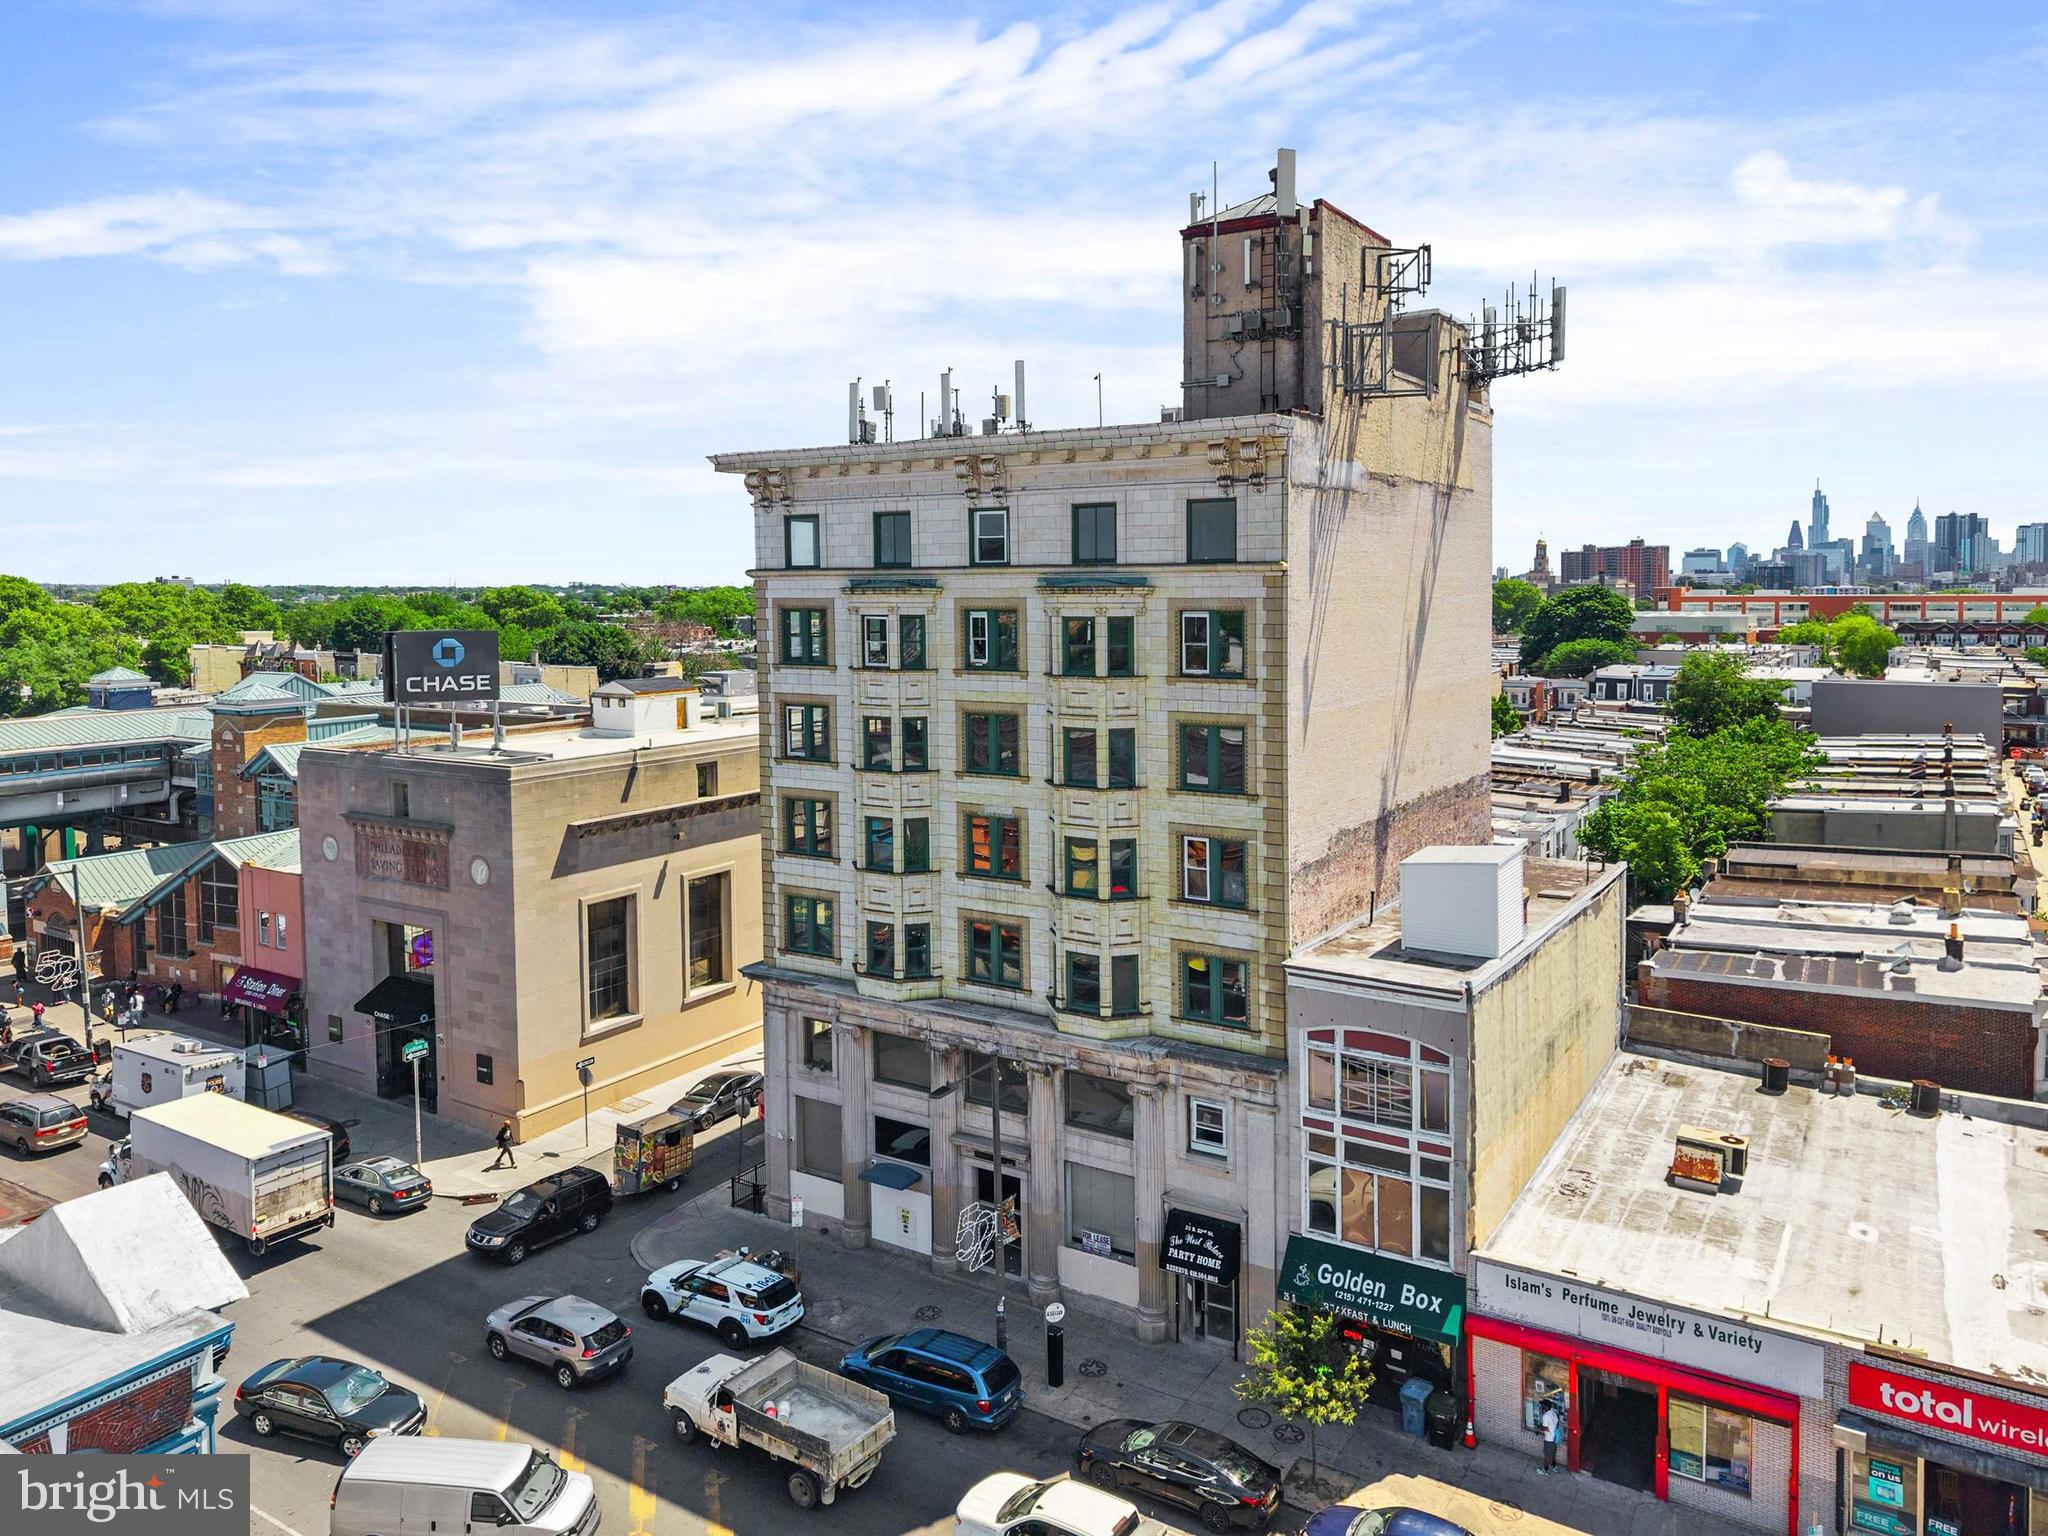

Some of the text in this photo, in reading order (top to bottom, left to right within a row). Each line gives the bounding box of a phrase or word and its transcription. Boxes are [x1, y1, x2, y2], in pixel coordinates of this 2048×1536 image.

[405, 674, 492, 693] CHASE
[243, 977, 267, 993] Station
[266, 983, 287, 998] Diner
[374, 1010, 390, 1020] CHASE
[1082, 1230, 1111, 1244] FOR LEASE
[1169, 1233, 1224, 1260] The West Palace
[1168, 1247, 1222, 1270] PARTY HOME
[1317, 1263, 1443, 1314] Golden Box
[1334, 1290, 1395, 1312] (215) 471-1227
[1505, 1274, 1763, 1354] Islam's Perfume Jewelry & Variety
[1372, 1315, 1379, 1325] &
[1382, 1317, 1412, 1334] LUNCH
[1880, 1382, 2048, 1448] total wirel
[1871, 1469, 1901, 1483] on us
[1855, 1510, 1890, 1527] FREE
[1927, 1518, 1959, 1535] FREE
